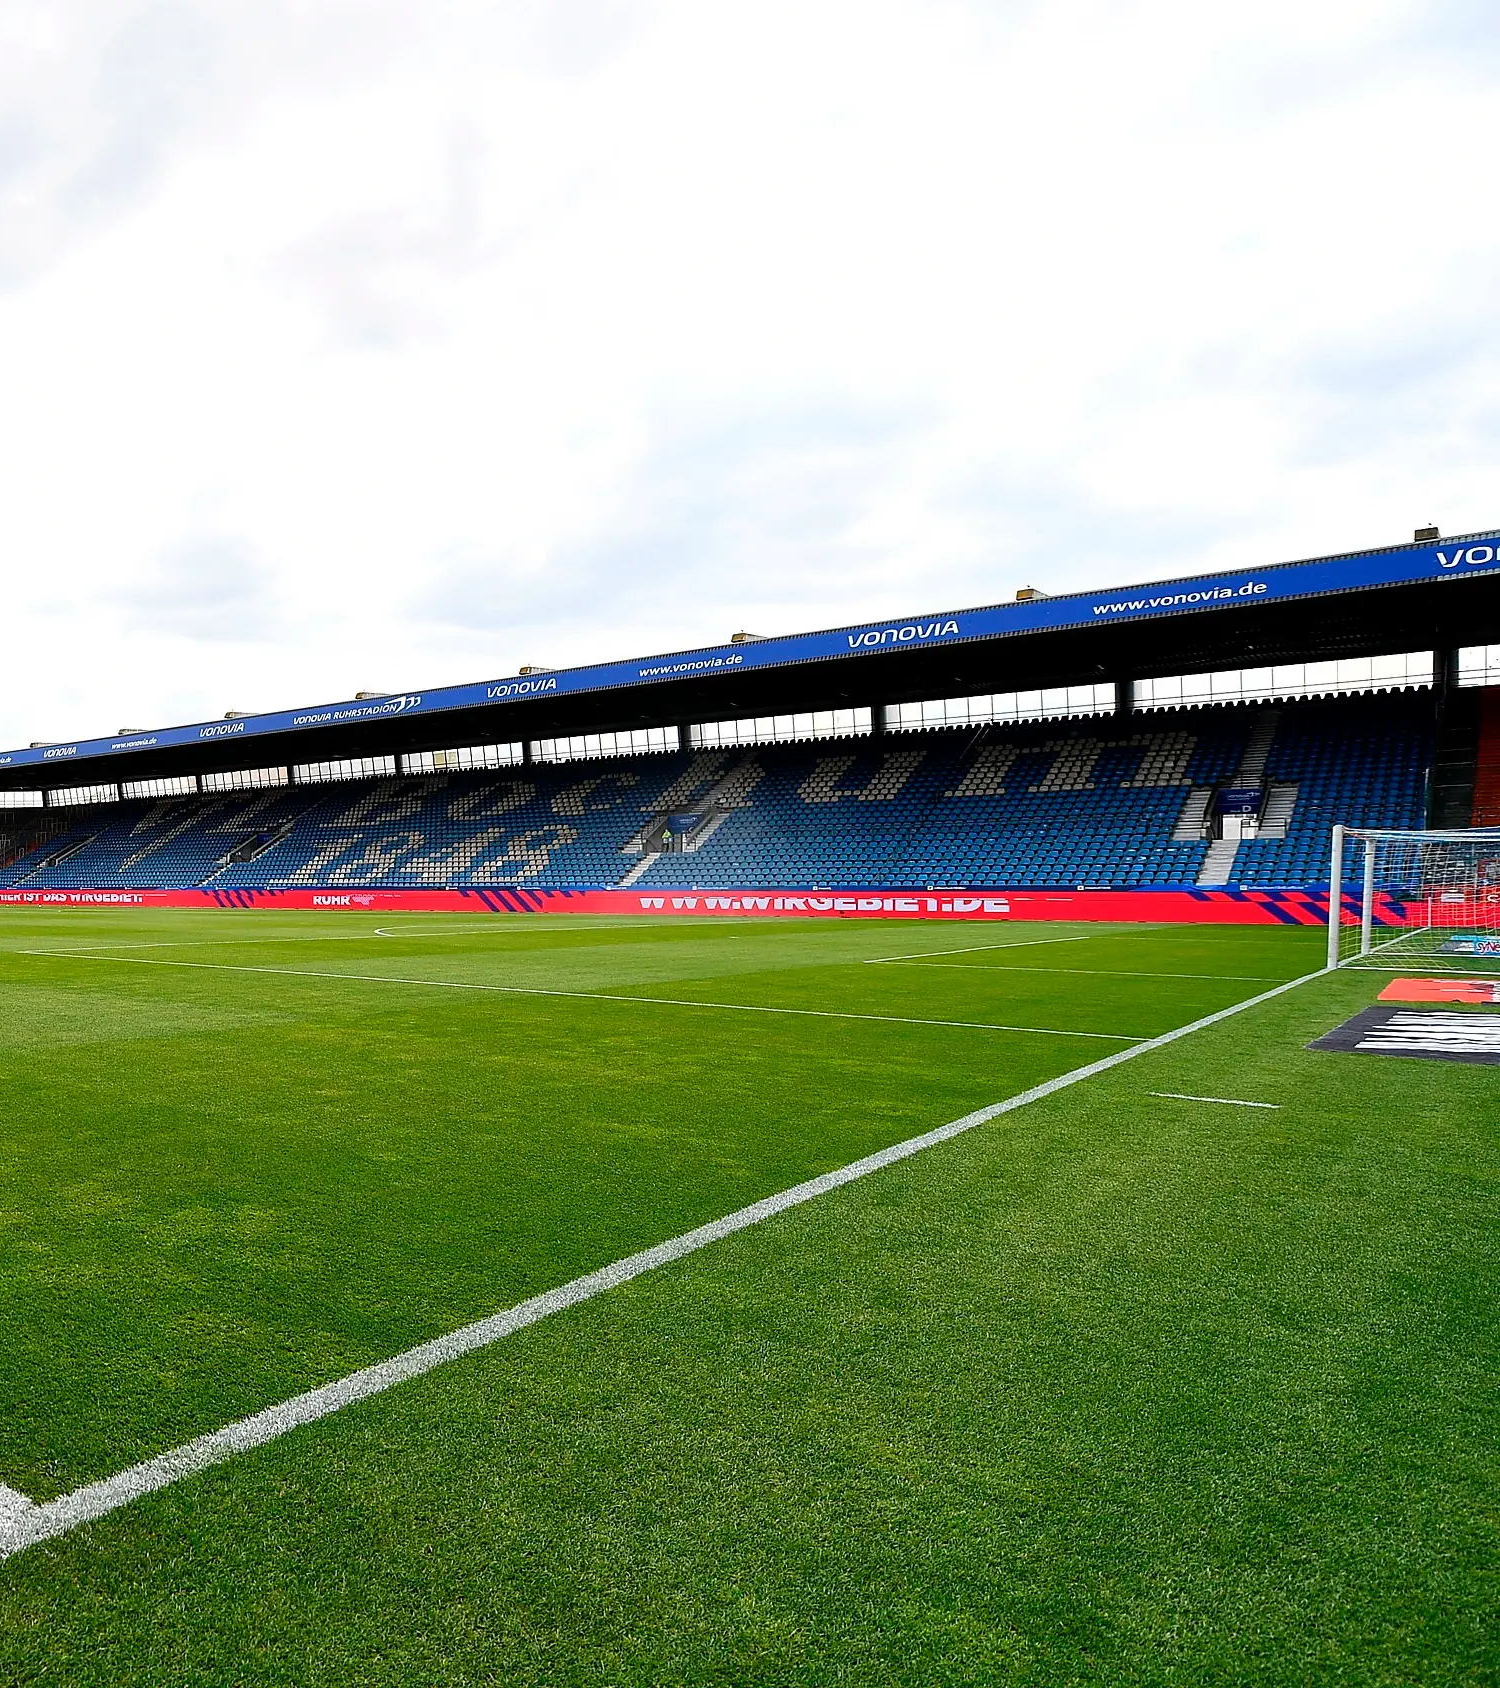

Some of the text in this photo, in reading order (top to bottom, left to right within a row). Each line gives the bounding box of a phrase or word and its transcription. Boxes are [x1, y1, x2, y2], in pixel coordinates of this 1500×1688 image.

[1436, 545, 1500, 568] VO
[1093, 581, 1268, 616] www.vonovia.de
[847, 620, 959, 648] VONOVIA
[638, 653, 743, 677] www.vonovia.de
[487, 678, 557, 698] VONOVIA
[293, 703, 398, 725] VONOVIA RUHRSTADION
[200, 722, 245, 738] VONOVIA
[43, 746, 77, 758] VONOVIA
[111, 736, 158, 750] www.vonovia.de
[1242, 805, 1252, 813] D
[313, 895, 351, 906] RUHR
